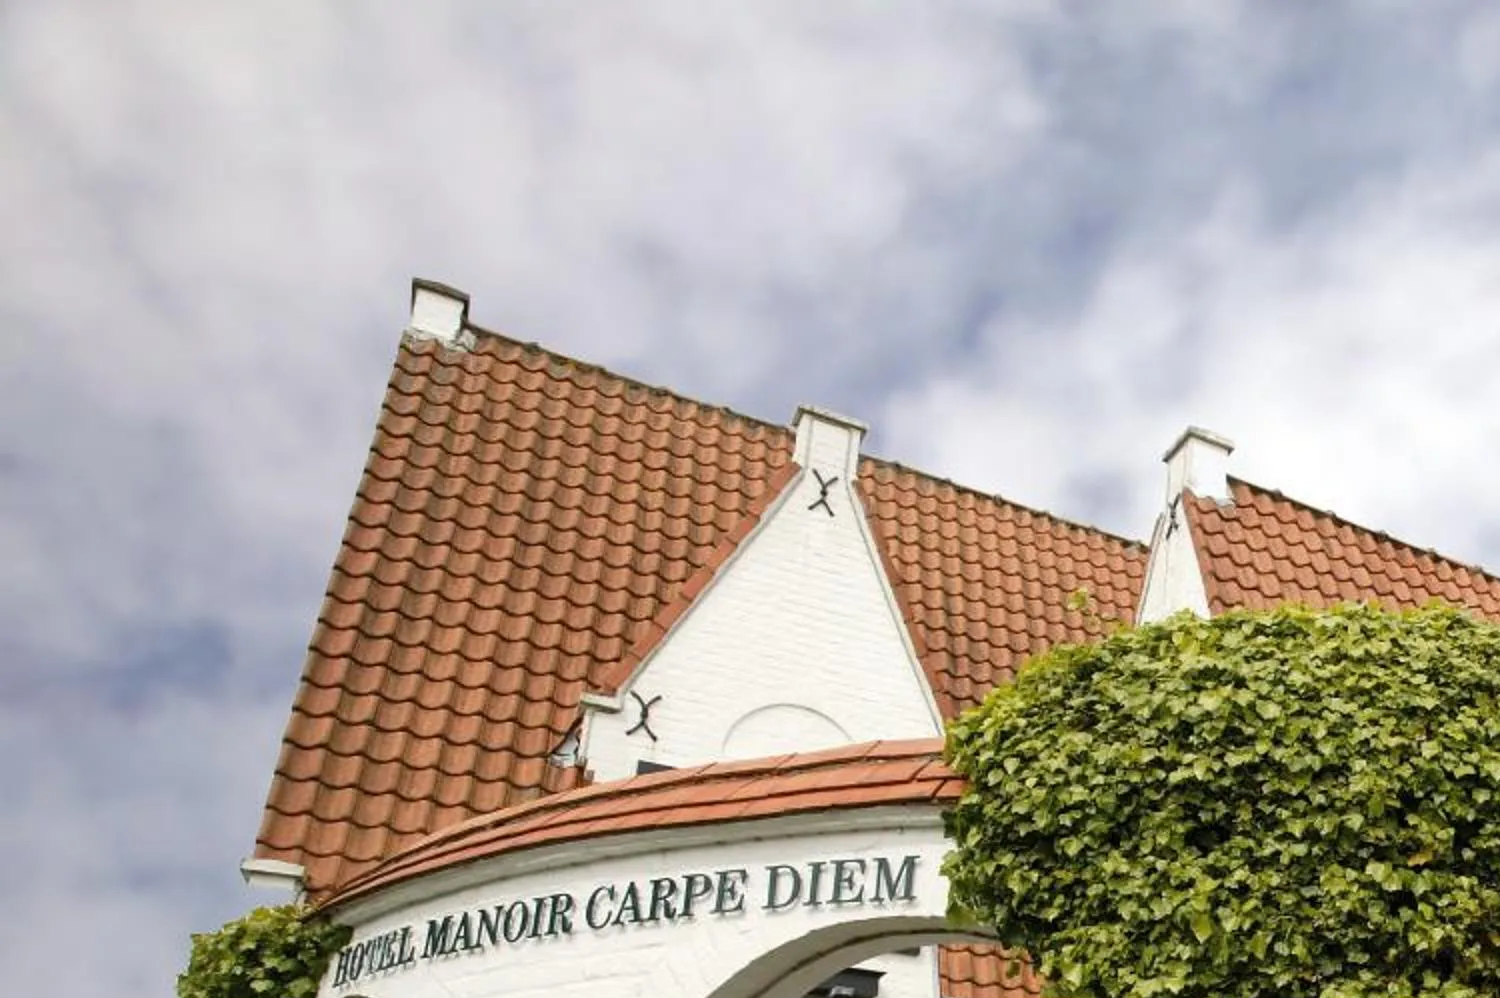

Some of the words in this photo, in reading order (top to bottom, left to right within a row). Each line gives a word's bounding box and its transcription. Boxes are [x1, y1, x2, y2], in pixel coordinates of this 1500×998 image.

[332, 925, 415, 988] HOTEL
[420, 893, 574, 958] MANOIR
[586, 869, 749, 929] CARPE
[761, 855, 921, 909] DIEM
